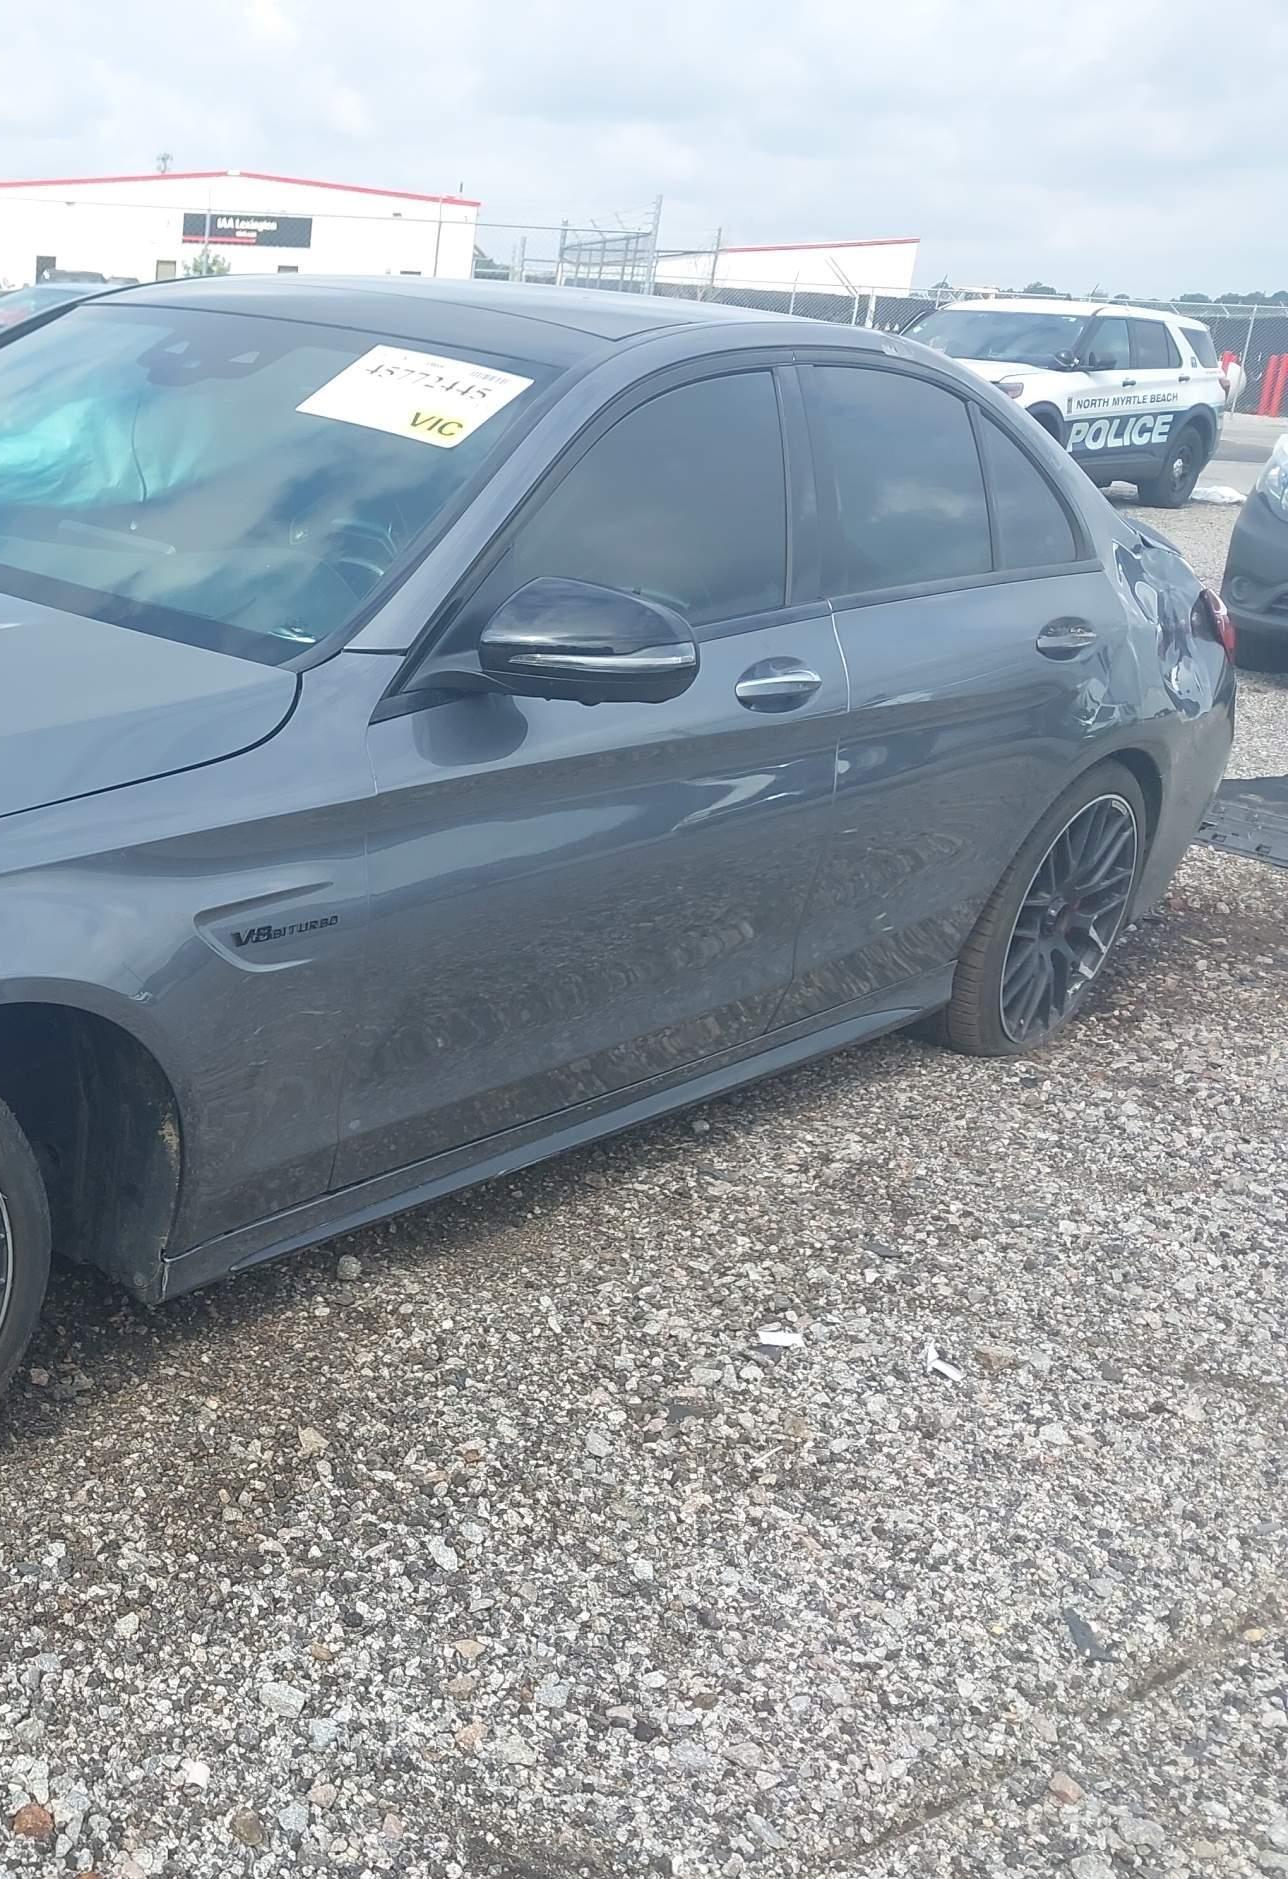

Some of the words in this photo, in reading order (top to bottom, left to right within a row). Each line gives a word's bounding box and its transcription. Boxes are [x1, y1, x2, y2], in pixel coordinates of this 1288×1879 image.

[365, 363, 492, 400] 45772445
[1076, 397, 1109, 410] NORTH
[1112, 395, 1147, 406] MYRTLE
[1149, 393, 1178, 404] BEACH
[410, 411, 464, 437] VIC
[1066, 414, 1174, 453] POLICE
